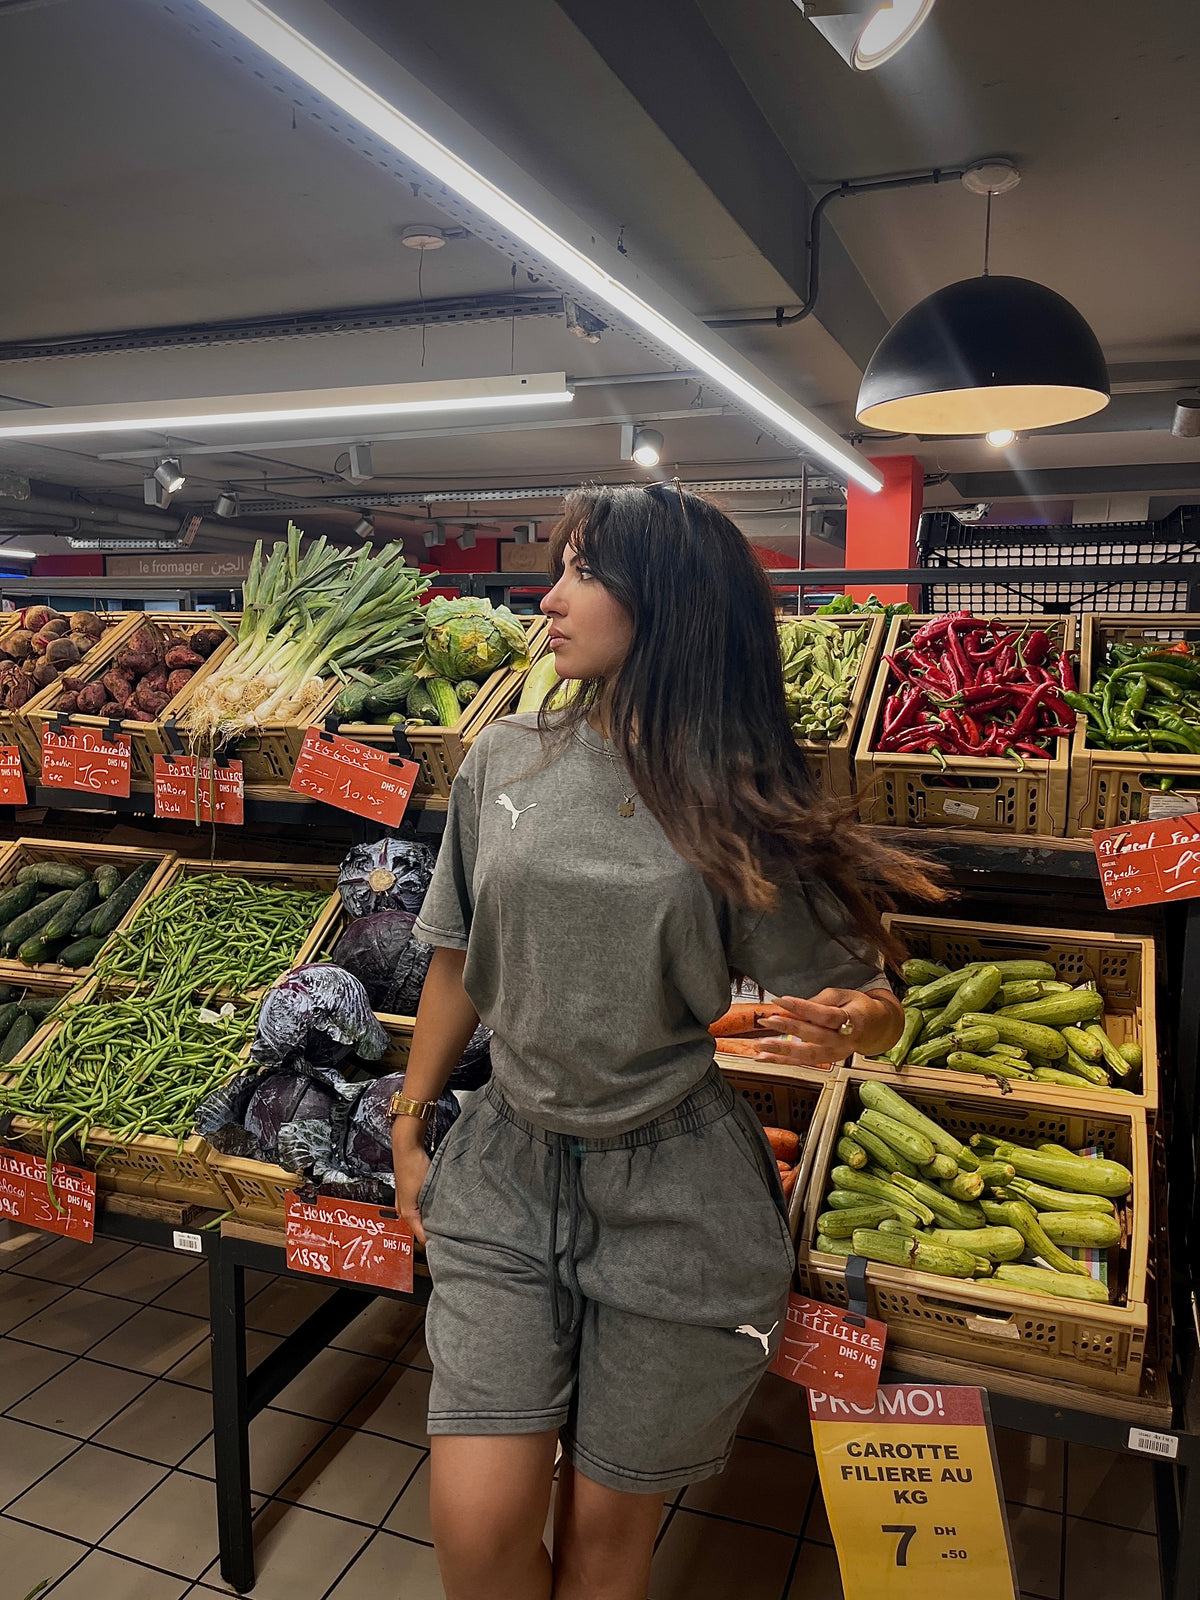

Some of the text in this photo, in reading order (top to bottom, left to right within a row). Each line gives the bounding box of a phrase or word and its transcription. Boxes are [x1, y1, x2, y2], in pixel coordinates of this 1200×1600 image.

[139, 560, 203, 576] le fromager
[380, 781, 408, 799] DHS/Kg
[67, 1194, 92, 1211] DHS/Kg
[383, 1239, 411, 1255] DHS/Kg
[838, 1345, 878, 1370] DHS/Kg
[846, 1441, 960, 1460] CAROTTE
[840, 1465, 973, 1483] FILIERE AU
[893, 1490, 928, 1505] KG
[881, 1524, 957, 1567] 7 DH
